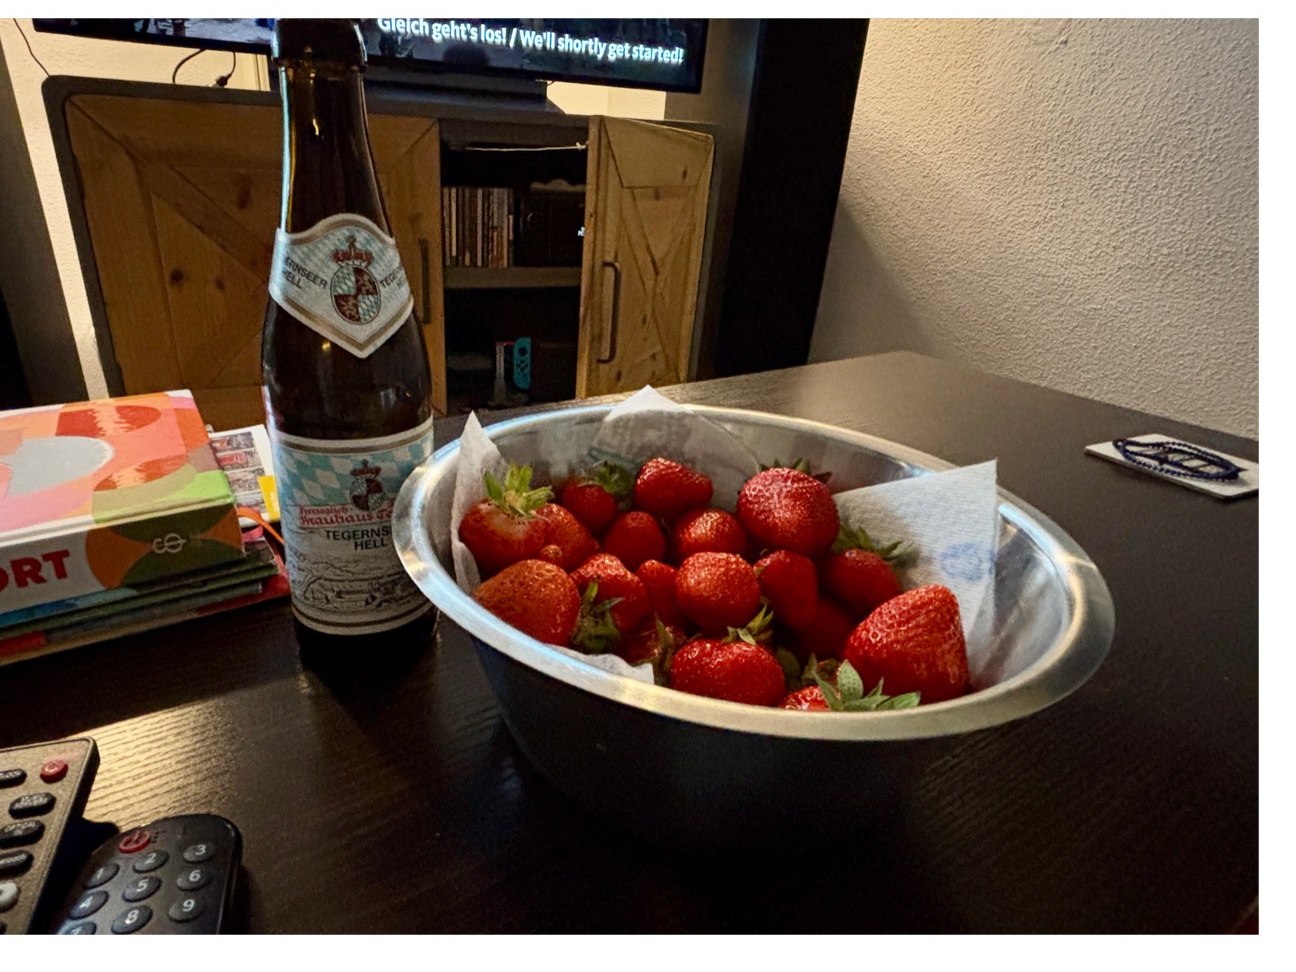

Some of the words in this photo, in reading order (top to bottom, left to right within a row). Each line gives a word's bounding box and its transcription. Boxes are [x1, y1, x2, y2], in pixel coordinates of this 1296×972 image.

[431, 20, 479, 44] geht's
[480, 24, 507, 45] los!
[519, 28, 556, 50] We'll
[557, 33, 606, 61] shortly
[607, 42, 631, 62] get
[631, 44, 684, 65] started!
[354, 539, 388, 551] HELL
[196, 844, 206, 855] 3
[145, 852, 156, 863] 2
[189, 869, 201, 882] 6
[136, 879, 148, 892] 5
[183, 899, 195, 912] 9
[125, 909, 138, 925] 8
